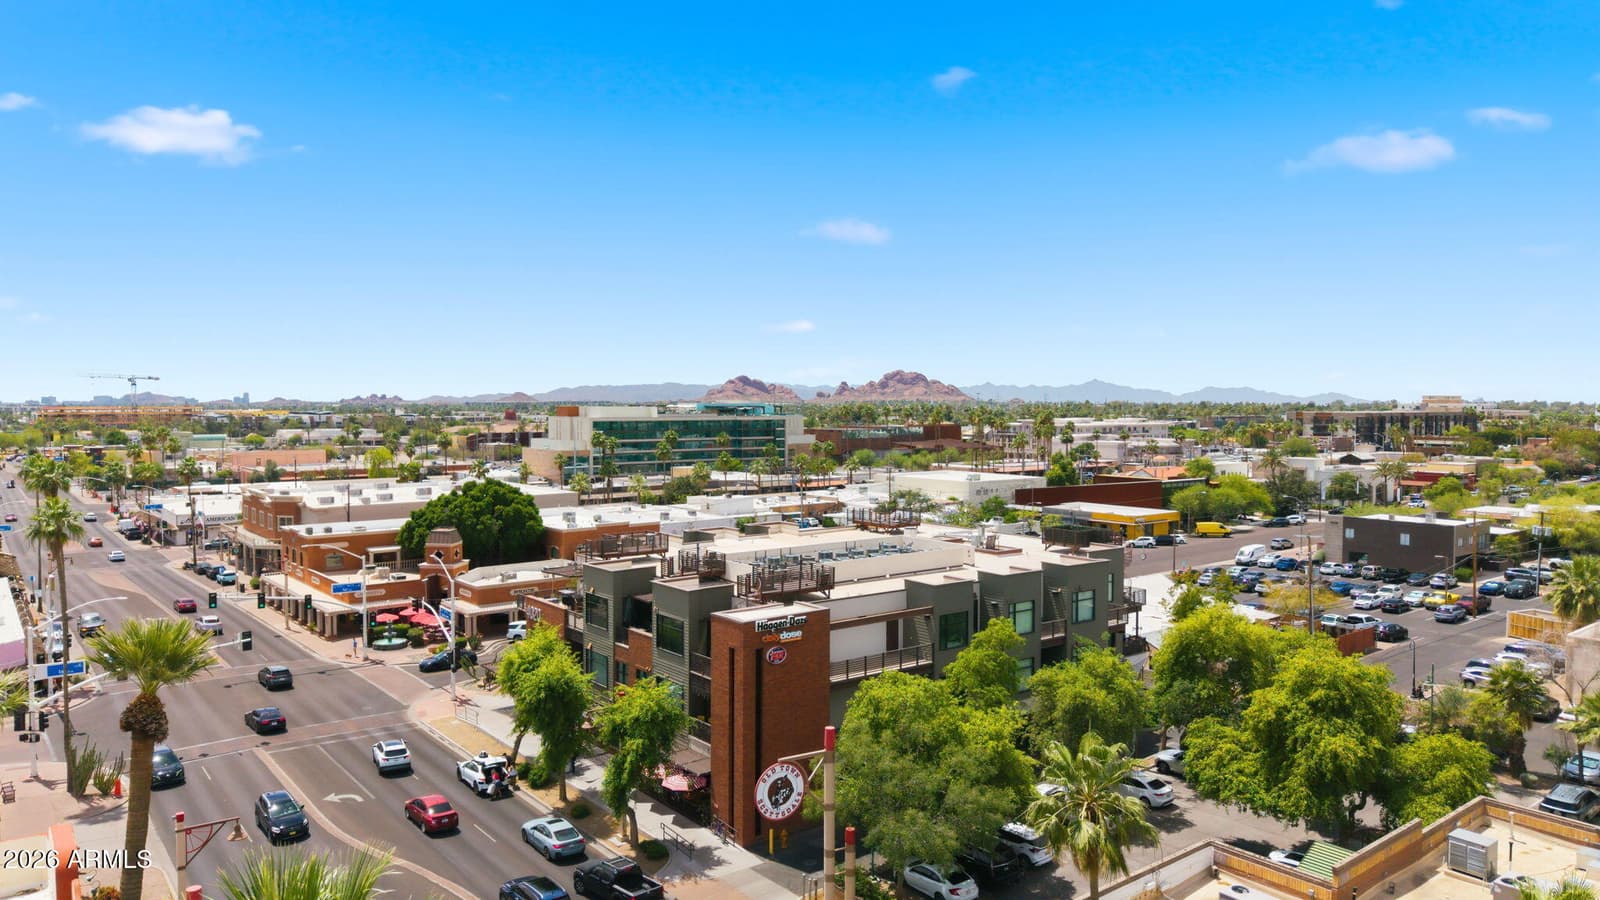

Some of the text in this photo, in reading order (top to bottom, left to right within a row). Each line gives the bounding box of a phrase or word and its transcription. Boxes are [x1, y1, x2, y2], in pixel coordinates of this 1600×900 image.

[779, 630, 803, 640] dose
[761, 765, 800, 784] OLD TOWN
[757, 792, 803, 818] SCOTTSDALE
